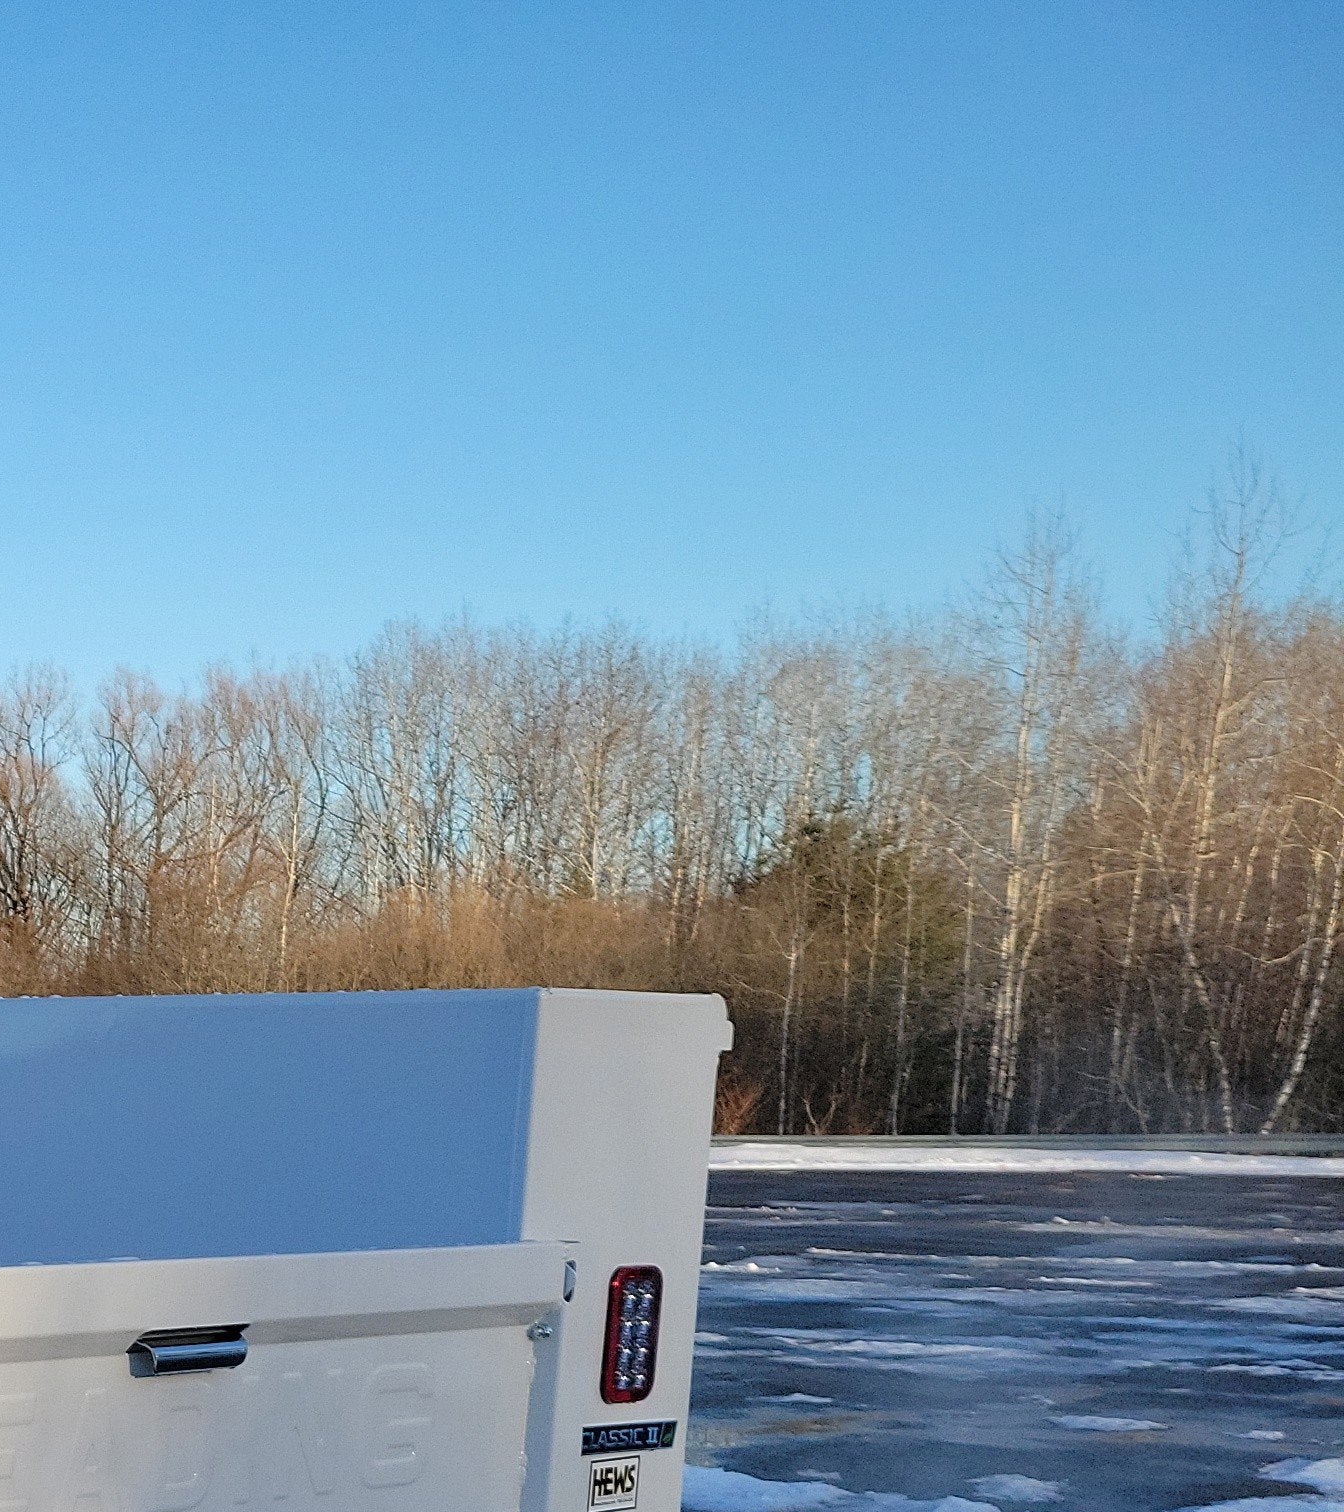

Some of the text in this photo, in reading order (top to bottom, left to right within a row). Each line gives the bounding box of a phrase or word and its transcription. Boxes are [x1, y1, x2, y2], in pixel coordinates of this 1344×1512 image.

[582, 1427, 660, 1450] CLASSIC II
[591, 1465, 636, 1506] HEWS
